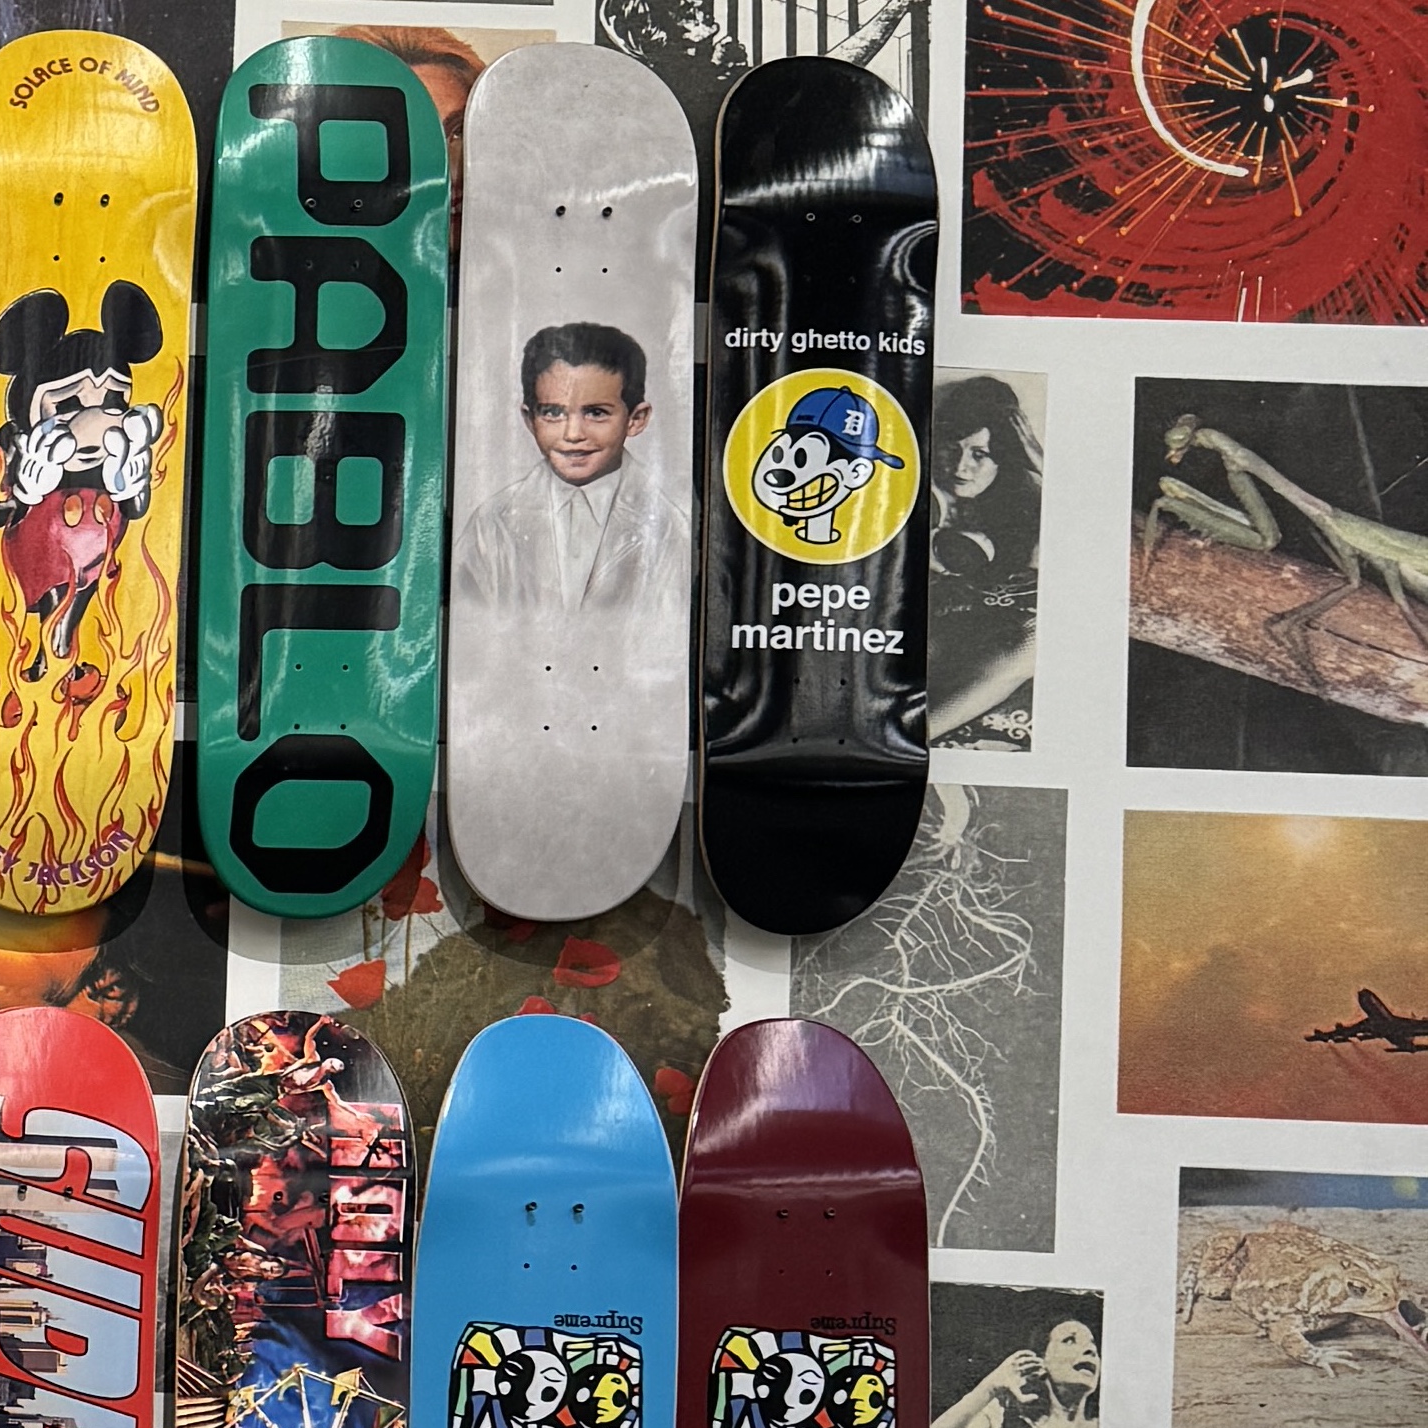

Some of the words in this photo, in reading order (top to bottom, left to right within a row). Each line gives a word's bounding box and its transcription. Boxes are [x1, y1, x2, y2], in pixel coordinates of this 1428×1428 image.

[9, 57, 74, 109] SOLACE
[79, 57, 113, 75] OF
[114, 69, 161, 112] MIND
[724, 328, 784, 352] dirty
[791, 328, 872, 354] ghetto
[878, 331, 926, 356] kids
[229, 84, 411, 894] PABLO
[771, 582, 871, 617] pepe
[731, 618, 905, 655] martinez
[22, 829, 136, 887] JACKSON
[553, 1310, 644, 1335] Supreme
[810, 1311, 897, 1337] Supreme
